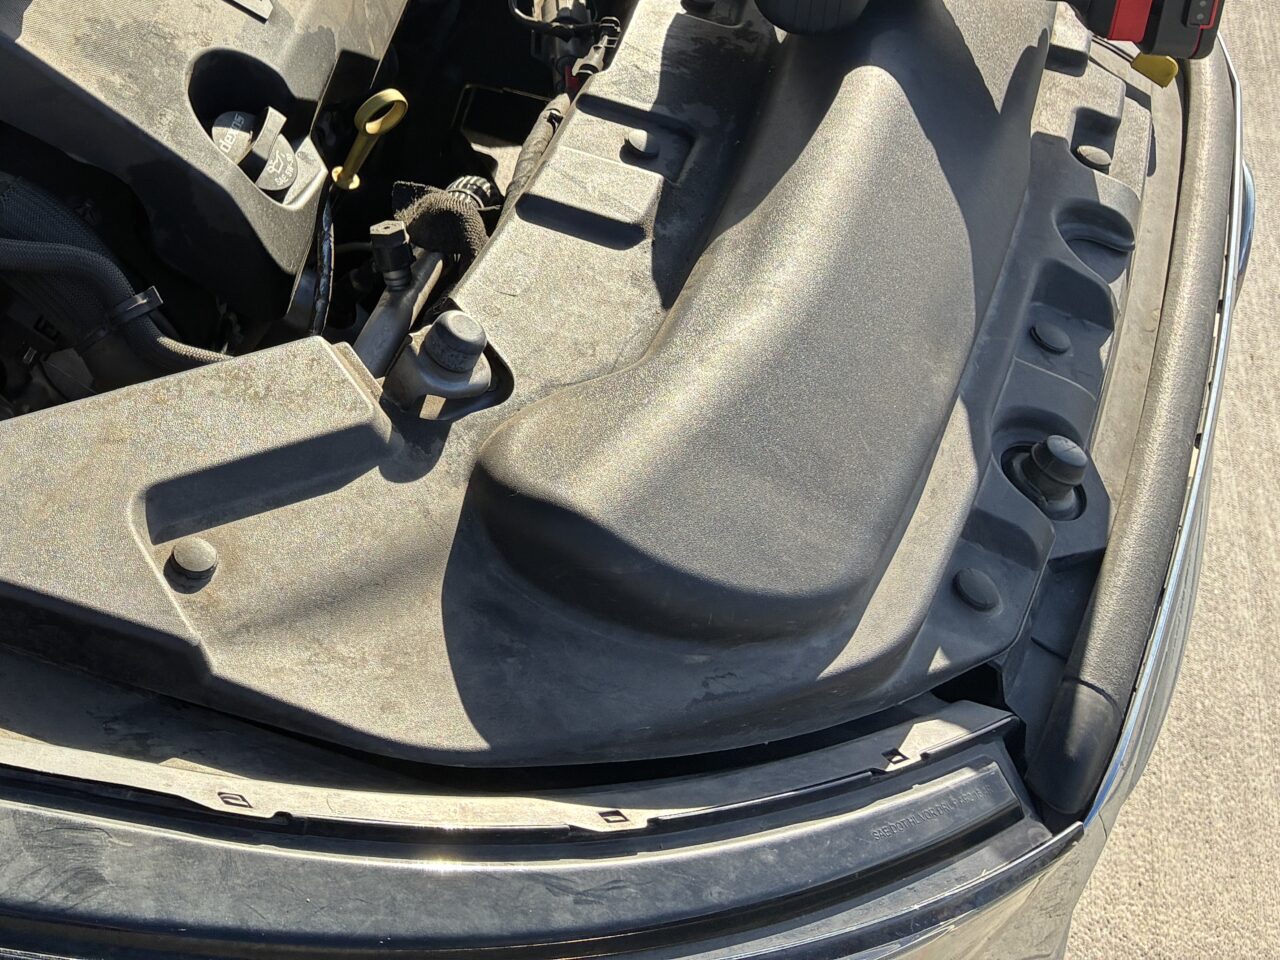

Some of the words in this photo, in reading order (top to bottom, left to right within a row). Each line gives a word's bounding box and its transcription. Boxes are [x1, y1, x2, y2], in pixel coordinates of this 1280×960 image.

[872, 825, 890, 841] SAE
[889, 818, 907, 833] DOT
[918, 807, 936, 823] VOR
